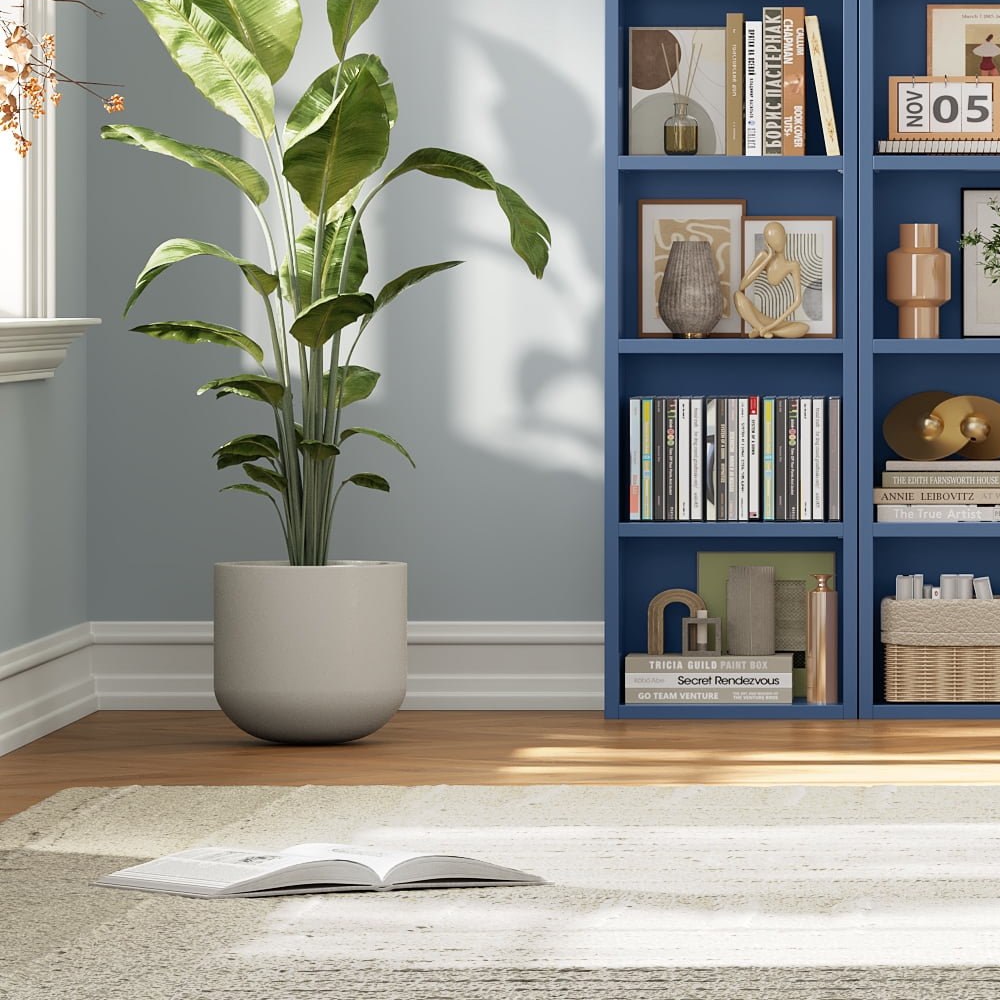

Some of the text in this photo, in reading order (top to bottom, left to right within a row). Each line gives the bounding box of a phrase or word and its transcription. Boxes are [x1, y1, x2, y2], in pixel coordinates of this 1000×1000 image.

[783, 18, 794, 65] CHAPMAN
[795, 27, 804, 56] CALLUM
[765, 15, 782, 148] БОРИС ПАСТЕРНАК
[906, 90, 923, 127] NOV
[784, 115, 793, 137] TUTS+
[793, 105, 803, 148] BOOK COVER
[893, 476, 999, 485] THE EDITH FARNSWORTH HOUSE
[881, 492, 914, 501] ANNIE
[921, 492, 974, 501] LEIBOVITZ
[894, 509, 982, 519] The True Artist
[649, 661, 768, 669] TRICIA GUILD PAINT BOX
[677, 675, 780, 685] Secret Rendezvous
[638, 692, 719, 700] GO TEAM VENTURE
